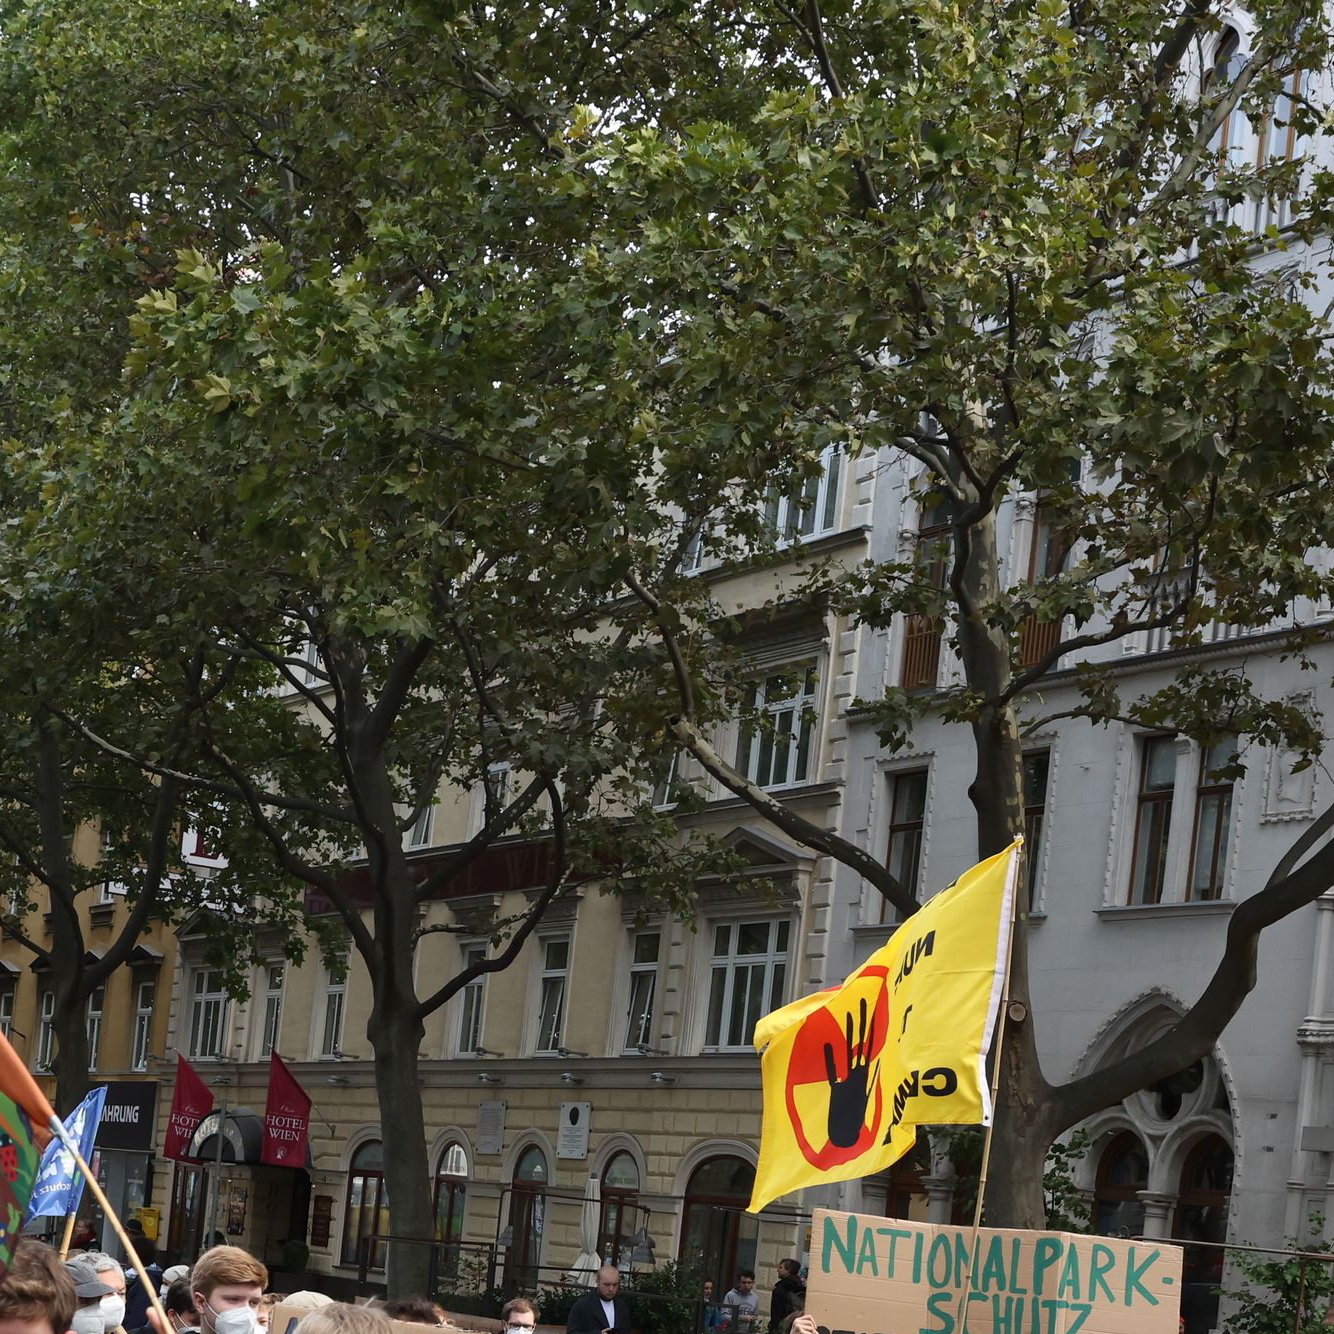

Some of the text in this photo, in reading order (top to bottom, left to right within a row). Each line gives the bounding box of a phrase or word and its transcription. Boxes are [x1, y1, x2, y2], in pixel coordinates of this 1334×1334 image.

[100, 1105, 139, 1123] AHRUNG
[267, 1114, 306, 1130] HOTEL
[269, 1127, 301, 1142] WIEN
